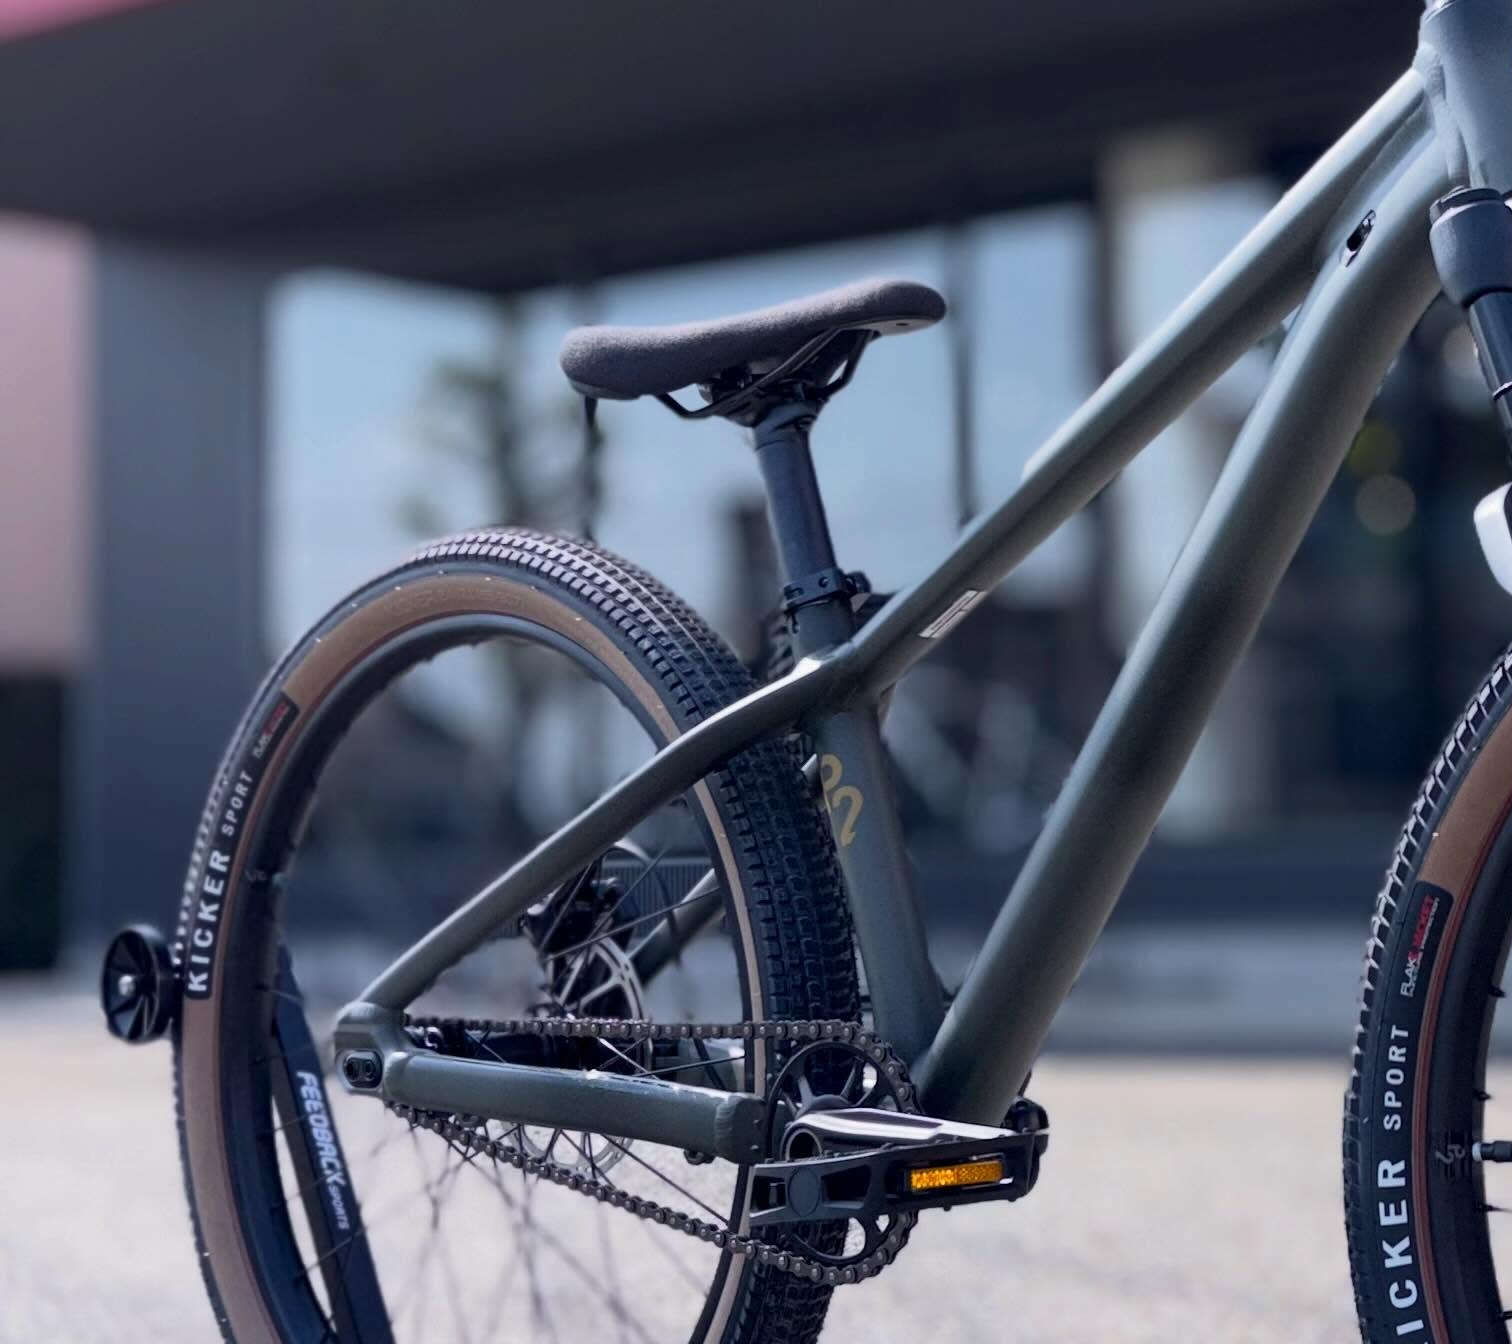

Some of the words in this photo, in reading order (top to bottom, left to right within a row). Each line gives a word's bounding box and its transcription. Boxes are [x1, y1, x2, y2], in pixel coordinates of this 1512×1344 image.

[188, 849, 231, 992] KICKER
[221, 770, 253, 837] SPORT
[296, 1069, 347, 1187] FEEDBACK
[328, 1183, 351, 1231] SPORTS
[1383, 1024, 1409, 1131] SPORT
